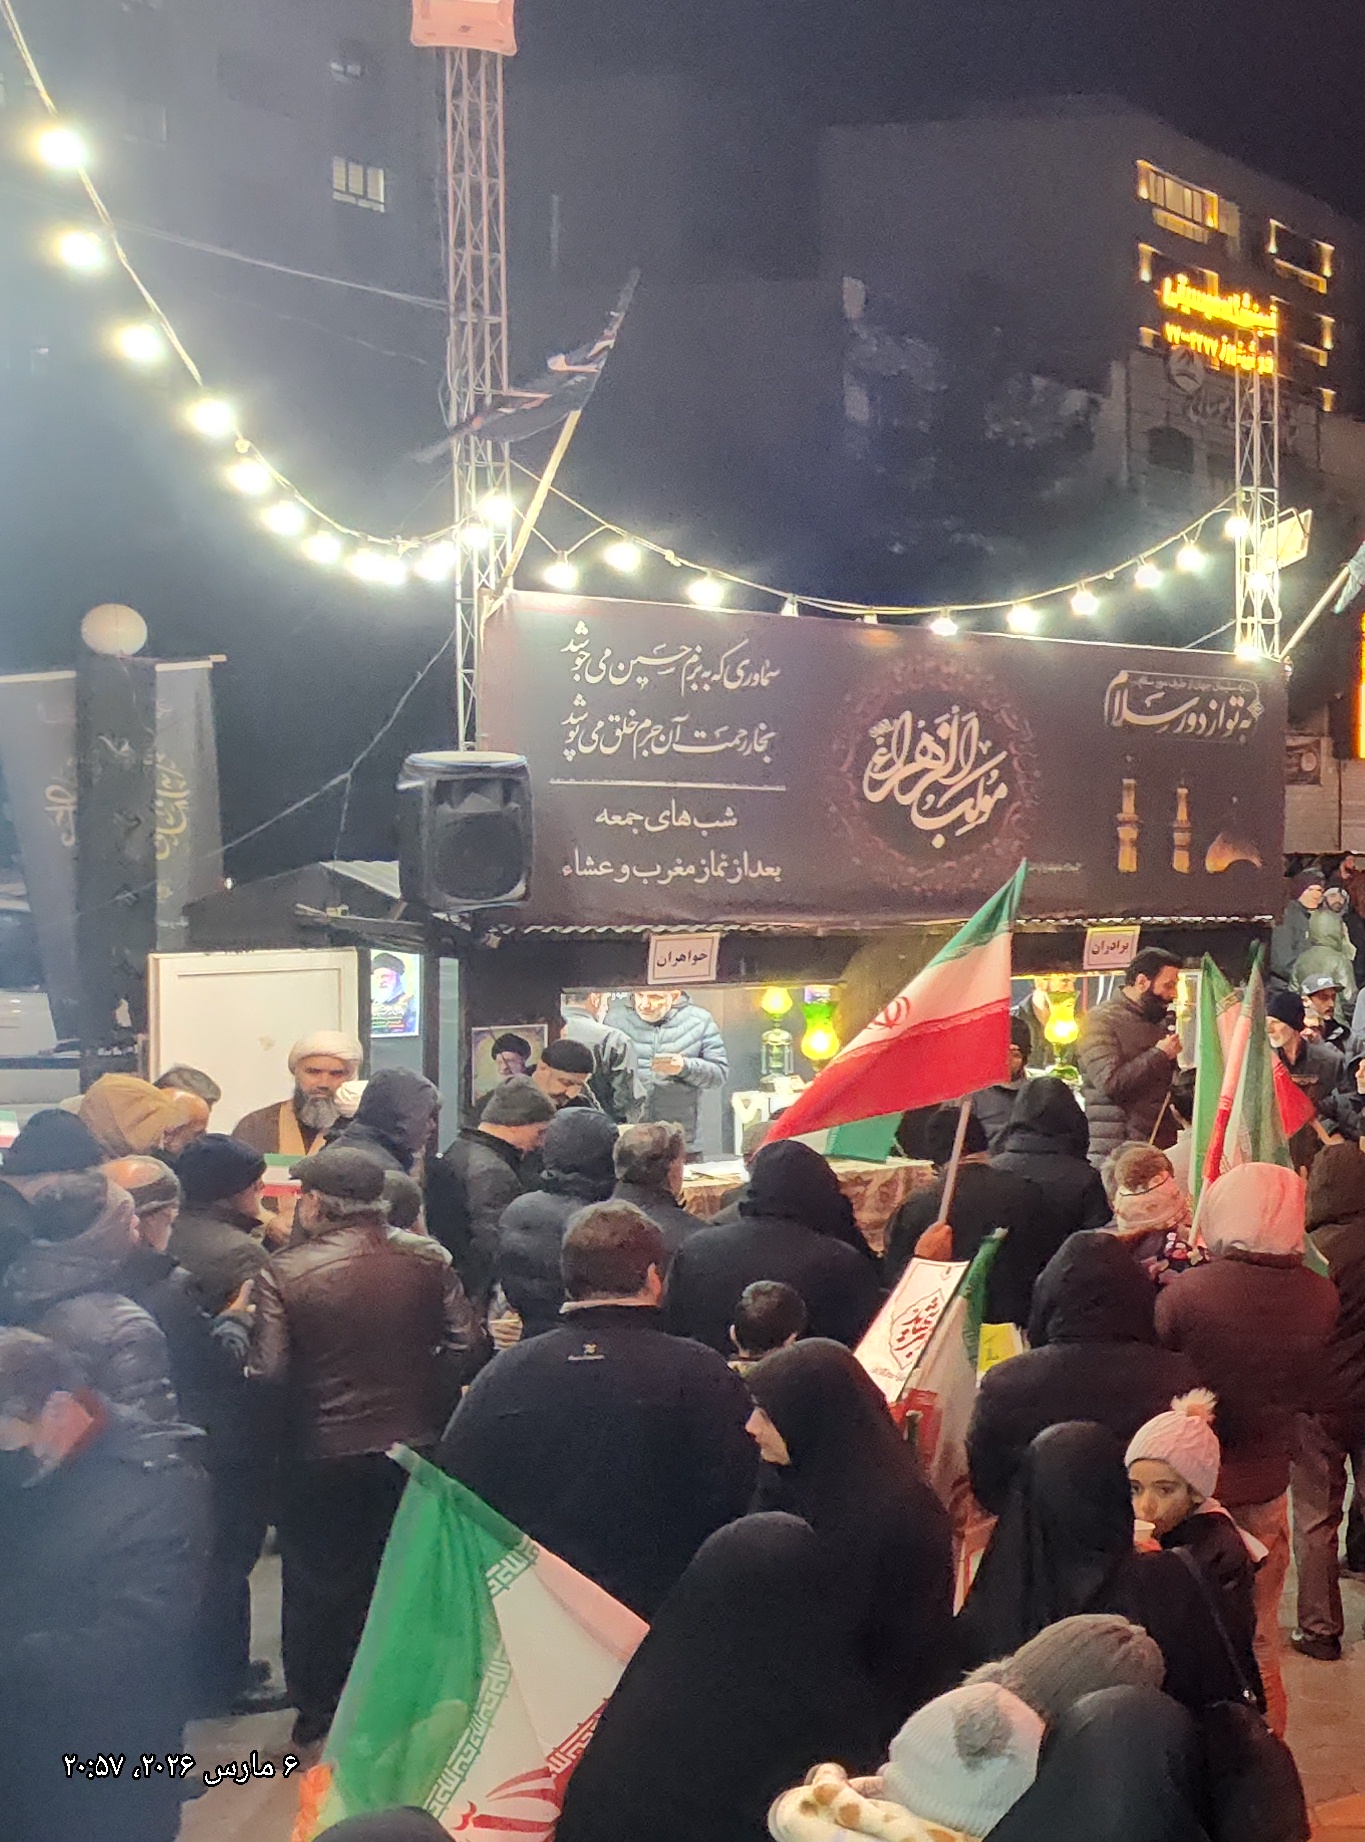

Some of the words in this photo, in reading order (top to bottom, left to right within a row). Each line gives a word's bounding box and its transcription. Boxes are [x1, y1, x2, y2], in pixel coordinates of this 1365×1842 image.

[608, 642, 693, 691] حسین
[680, 643, 703, 698] بزم
[711, 638, 750, 682] که
[721, 657, 781, 690] سماوری
[1103, 669, 1201, 728] سلام
[1220, 694, 1245, 738] تو
[600, 707, 640, 756] خلق
[650, 712, 691, 756] آن
[1204, 698, 1227, 737] از
[632, 717, 665, 761] جرم
[672, 724, 748, 756] رحمت
[743, 721, 779, 764] بخار
[594, 807, 645, 835] جمعه
[561, 847, 615, 877] عشاء
[613, 861, 631, 883] و
[632, 857, 696, 885] مغرب
[693, 848, 729, 884] نماز
[726, 849, 749, 884] از
[748, 858, 783, 883] بعد
[655, 949, 709, 969] خواهران
[1091, 939, 1131, 956] برادران
